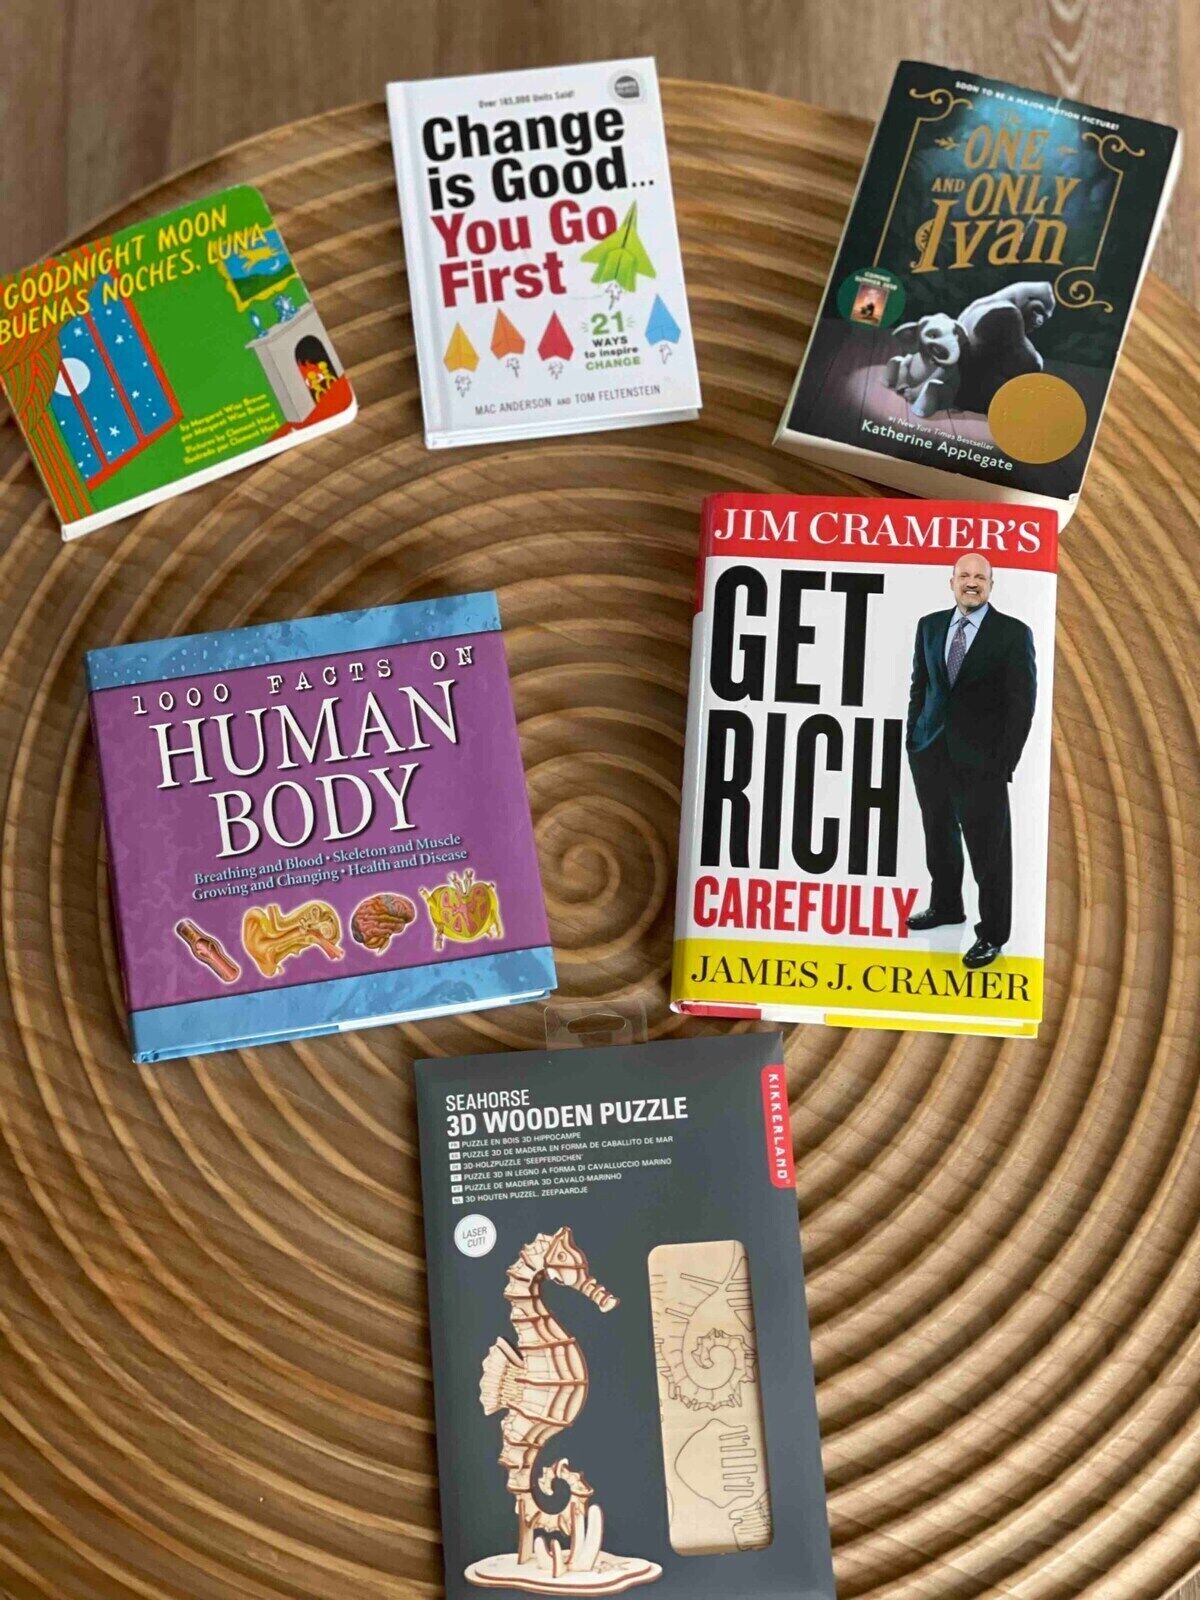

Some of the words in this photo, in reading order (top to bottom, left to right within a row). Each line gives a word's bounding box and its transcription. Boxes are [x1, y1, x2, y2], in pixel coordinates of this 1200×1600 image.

[955, 81, 980, 93] SOON
[982, 88, 993, 96] TO
[995, 92, 1006, 100] BE
[1016, 96, 1044, 110] MAJOR
[1047, 106, 1080, 120] MOTION
[422, 107, 625, 162] Change
[964, 124, 1049, 170] ONE
[428, 166, 475, 211] is
[491, 146, 654, 203] Good...
[932, 178, 966, 192] AND
[965, 172, 1082, 218] ONLY
[431, 213, 532, 258] You
[549, 199, 618, 246] Go
[909, 198, 1068, 274] Ivan
[4, 235, 146, 310] GOODNIGHT
[158, 204, 227, 252] MOON
[440, 252, 567, 308] First
[0, 289, 90, 345] BUENAS
[208, 222, 268, 264] LUNA
[591, 311, 624, 336] 21
[592, 336, 628, 348] WAYS
[586, 356, 640, 370] CHANGE
[600, 346, 638, 356] inspire
[475, 404, 497, 415] MAC
[500, 398, 551, 412] ANDERSON
[557, 398, 571, 406] AND
[575, 392, 596, 404] TOM
[598, 385, 660, 402] FELTENSTEIN
[861, 419, 934, 450] Katherine
[937, 441, 1014, 472] Applegate
[898, 418, 915, 429] New
[916, 424, 932, 434] York
[934, 428, 956, 440] Times
[956, 434, 994, 450] Bestseller
[714, 508, 799, 542] JIM
[809, 511, 1041, 553] CRAMER'S
[710, 564, 885, 707] GET
[132, 683, 229, 714] 1000
[266, 658, 392, 694] FACTS
[430, 645, 472, 670] ON
[149, 678, 458, 788] HUMAN
[209, 763, 420, 858] BODY
[700, 709, 904, 878] RICH
[192, 884, 248, 900] Growing
[250, 876, 274, 891] and
[277, 868, 338, 886] Changing
[348, 860, 391, 876] Health
[393, 856, 418, 870] and
[420, 850, 467, 865] Disease
[194, 866, 257, 885] Breathing
[259, 860, 283, 873] and
[286, 853, 324, 870] Blood
[333, 848, 387, 862] Skeleton
[386, 840, 414, 854] and
[416, 834, 461, 850] Muscle
[693, 875, 920, 938] CAREFULLY
[691, 955, 820, 988] JAMES
[826, 962, 852, 992] J.
[862, 964, 1032, 1002] CRAMER
[446, 1088, 530, 1112] SEAHORSE
[446, 1113, 477, 1137] 3D
[482, 1103, 593, 1134] WOODEN
[600, 1096, 688, 1125] PUZZLE
[462, 1140, 489, 1148] PUZZLE
[490, 1138, 500, 1146] EN
[502, 1137, 520, 1145] BOIS
[534, 1132, 582, 1142] HIPPOCAMPE
[462, 1150, 490, 1158] PUZZLE
[504, 1148, 514, 1156] DE
[516, 1146, 548, 1154] MADERA
[550, 1144, 560, 1152] EN
[561, 1142, 588, 1151] FORMA
[602, 1138, 642, 1148] CABALLITO
[644, 1136, 654, 1144] DE
[768, 1073, 788, 1179] KIKKERLAND
[463, 1158, 522, 1170] 3D-HOLZPUZZLE
[464, 1172, 491, 1180] PUZZLE
[514, 1168, 540, 1176] LEGNO
[549, 1165, 576, 1174] FORMA
[578, 1164, 586, 1172] DI
[588, 1160, 640, 1171] CAVALLUCCIO
[642, 1158, 672, 1166] MARINO
[464, 1182, 492, 1192] PUZZLE
[506, 1178, 540, 1188] MADEIRA
[542, 1178, 552, 1186] 3D
[554, 1172, 622, 1184] CAVALO-MARINHO
[478, 1192, 508, 1202] HOUTEN
[541, 1186, 588, 1196] ZEEPAARDJE
[462, 1226, 488, 1240] LASER
